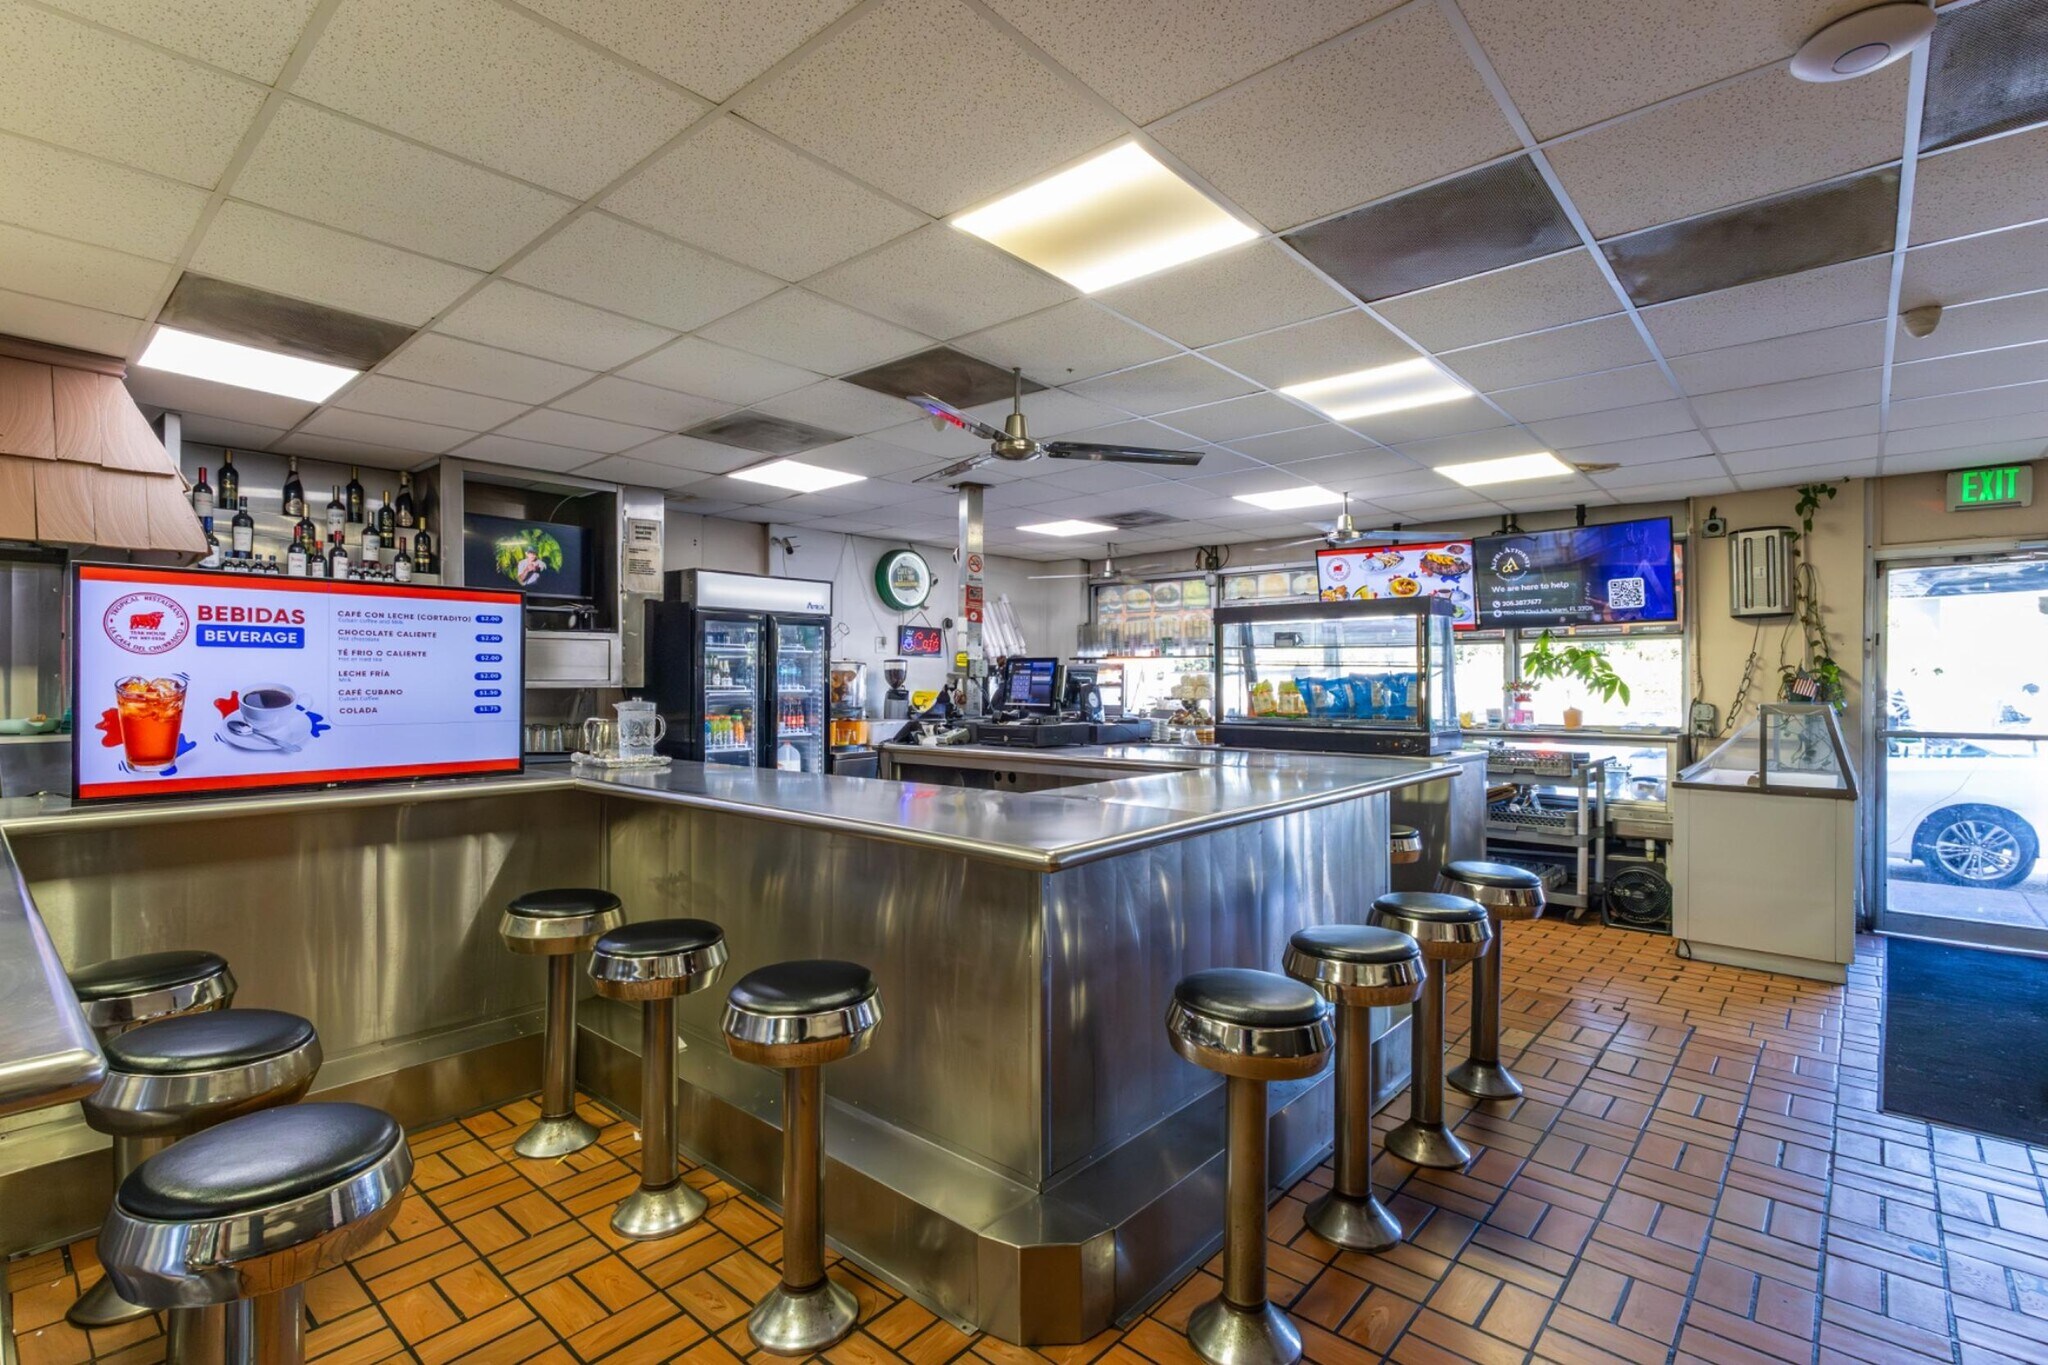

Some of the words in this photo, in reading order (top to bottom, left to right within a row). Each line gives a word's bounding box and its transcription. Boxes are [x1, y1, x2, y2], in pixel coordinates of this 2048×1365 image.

[1961, 467, 2020, 502] EXIT
[1550, 581, 1569, 589] help
[110, 596, 140, 616] TROPICAL
[144, 596, 183, 619] RESTAURANT
[198, 605, 305, 625] BEBIDAS
[364, 611, 385, 619] CON
[387, 612, 415, 620] LECHE
[417, 614, 472, 623] (CORTADITO)
[115, 634, 131, 648] CASA
[132, 644, 145, 652] DEL
[148, 628, 184, 652] CHURRASCO
[204, 630, 298, 644] BEVERAGE
[337, 629, 394, 637] CHOCOLATE
[370, 669, 390, 677] FRÍA
[338, 688, 362, 696] CAFÉ
